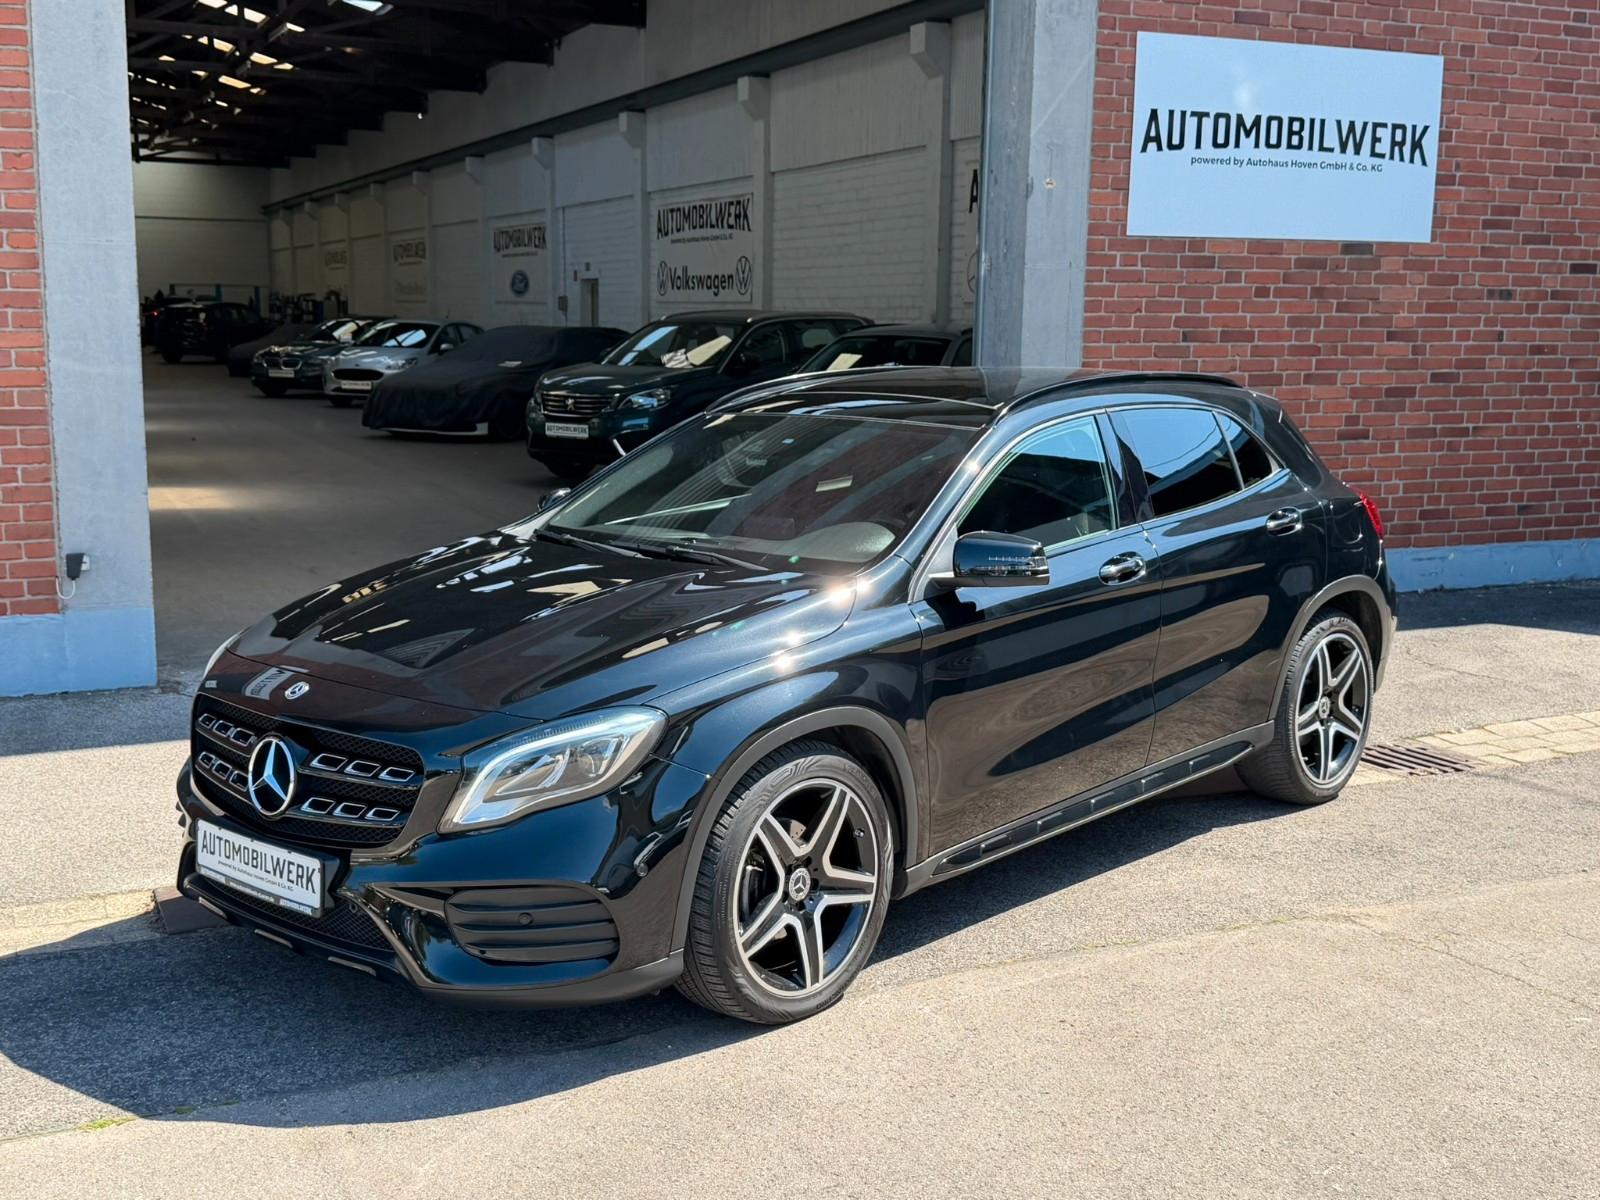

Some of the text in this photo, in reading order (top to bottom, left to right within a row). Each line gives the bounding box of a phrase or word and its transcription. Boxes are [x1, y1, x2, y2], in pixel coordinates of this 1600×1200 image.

[1140, 108, 1430, 167] AUTOMOBILWERK
[1190, 156, 1231, 166] powered
[1233, 156, 1244, 167] by
[1246, 158, 1289, 168] Autohaus
[1290, 159, 1318, 169] Hoven
[1319, 161, 1347, 171] GmbH
[1356, 162, 1368, 172] Co.
[1371, 163, 1383, 173] KG
[657, 198, 752, 240] AUTOMOBILWERK
[669, 265, 734, 297] Volkswagen
[201, 830, 317, 894] AUTOMOBILWERK
